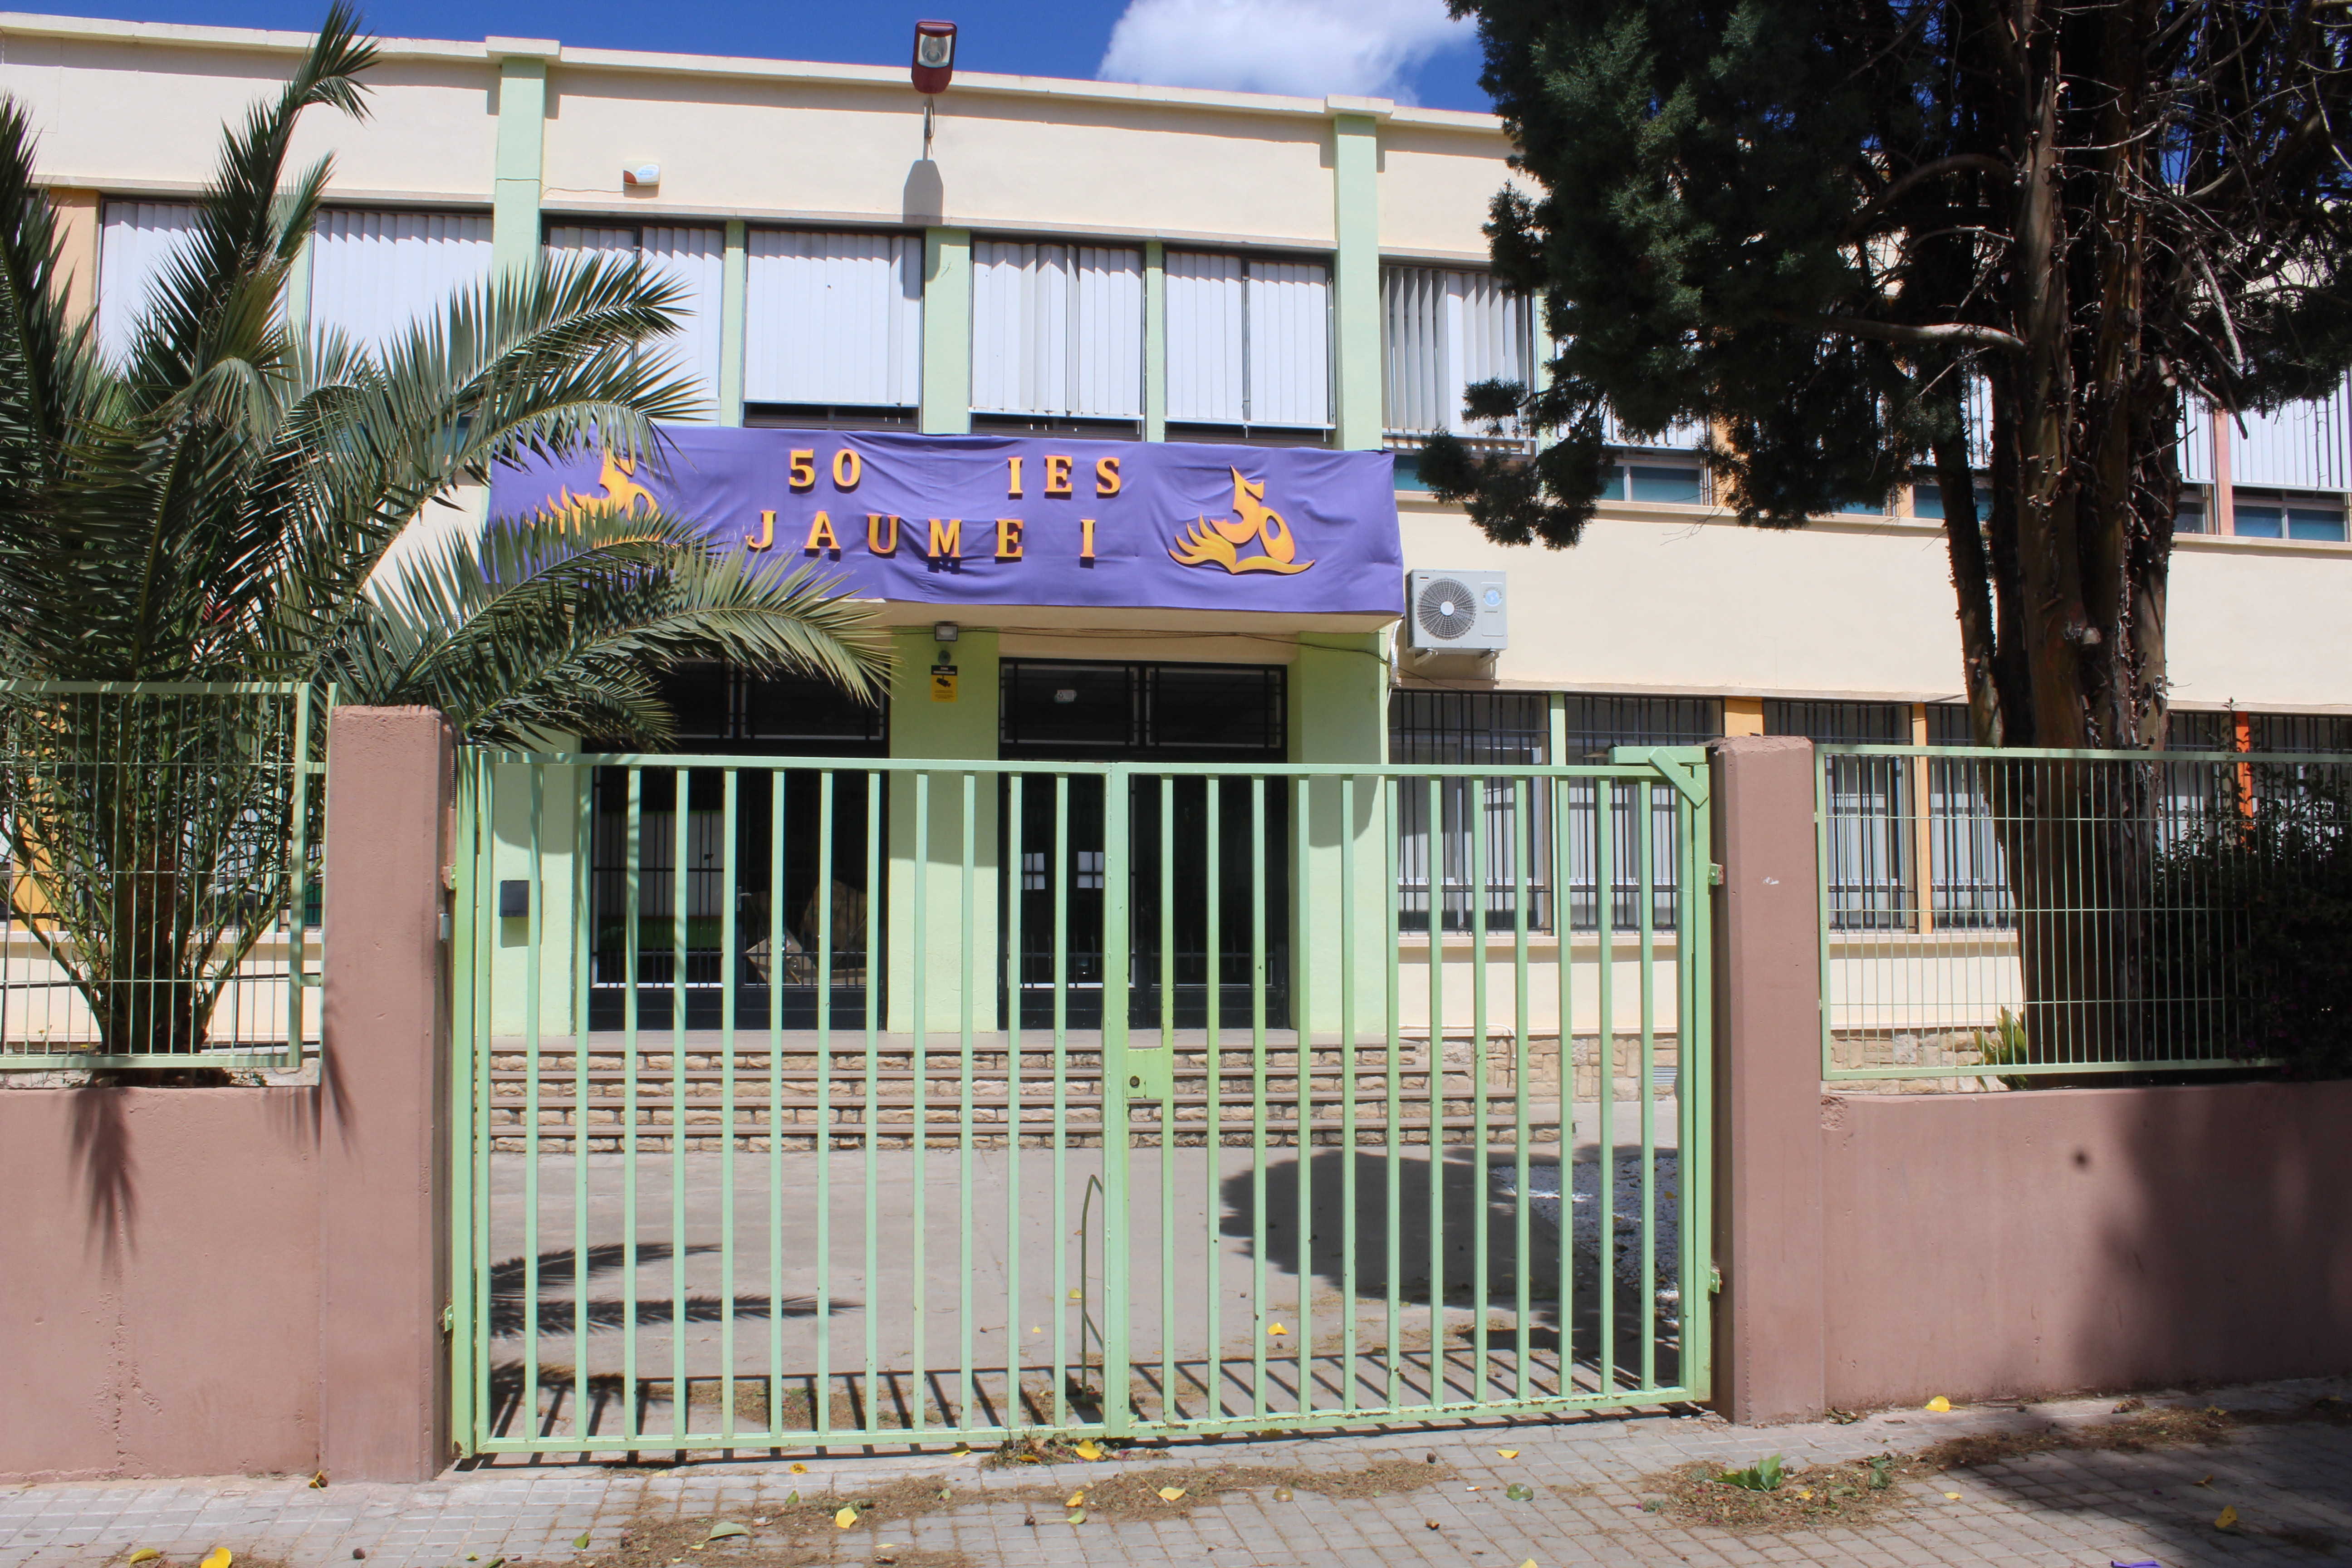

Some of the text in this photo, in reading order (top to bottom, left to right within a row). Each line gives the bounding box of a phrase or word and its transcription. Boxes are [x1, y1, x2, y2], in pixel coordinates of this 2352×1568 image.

[789, 449, 1121, 494] 50 IES
[745, 510, 1096, 558] JAUME I
[1210, 465, 1296, 564] 50
